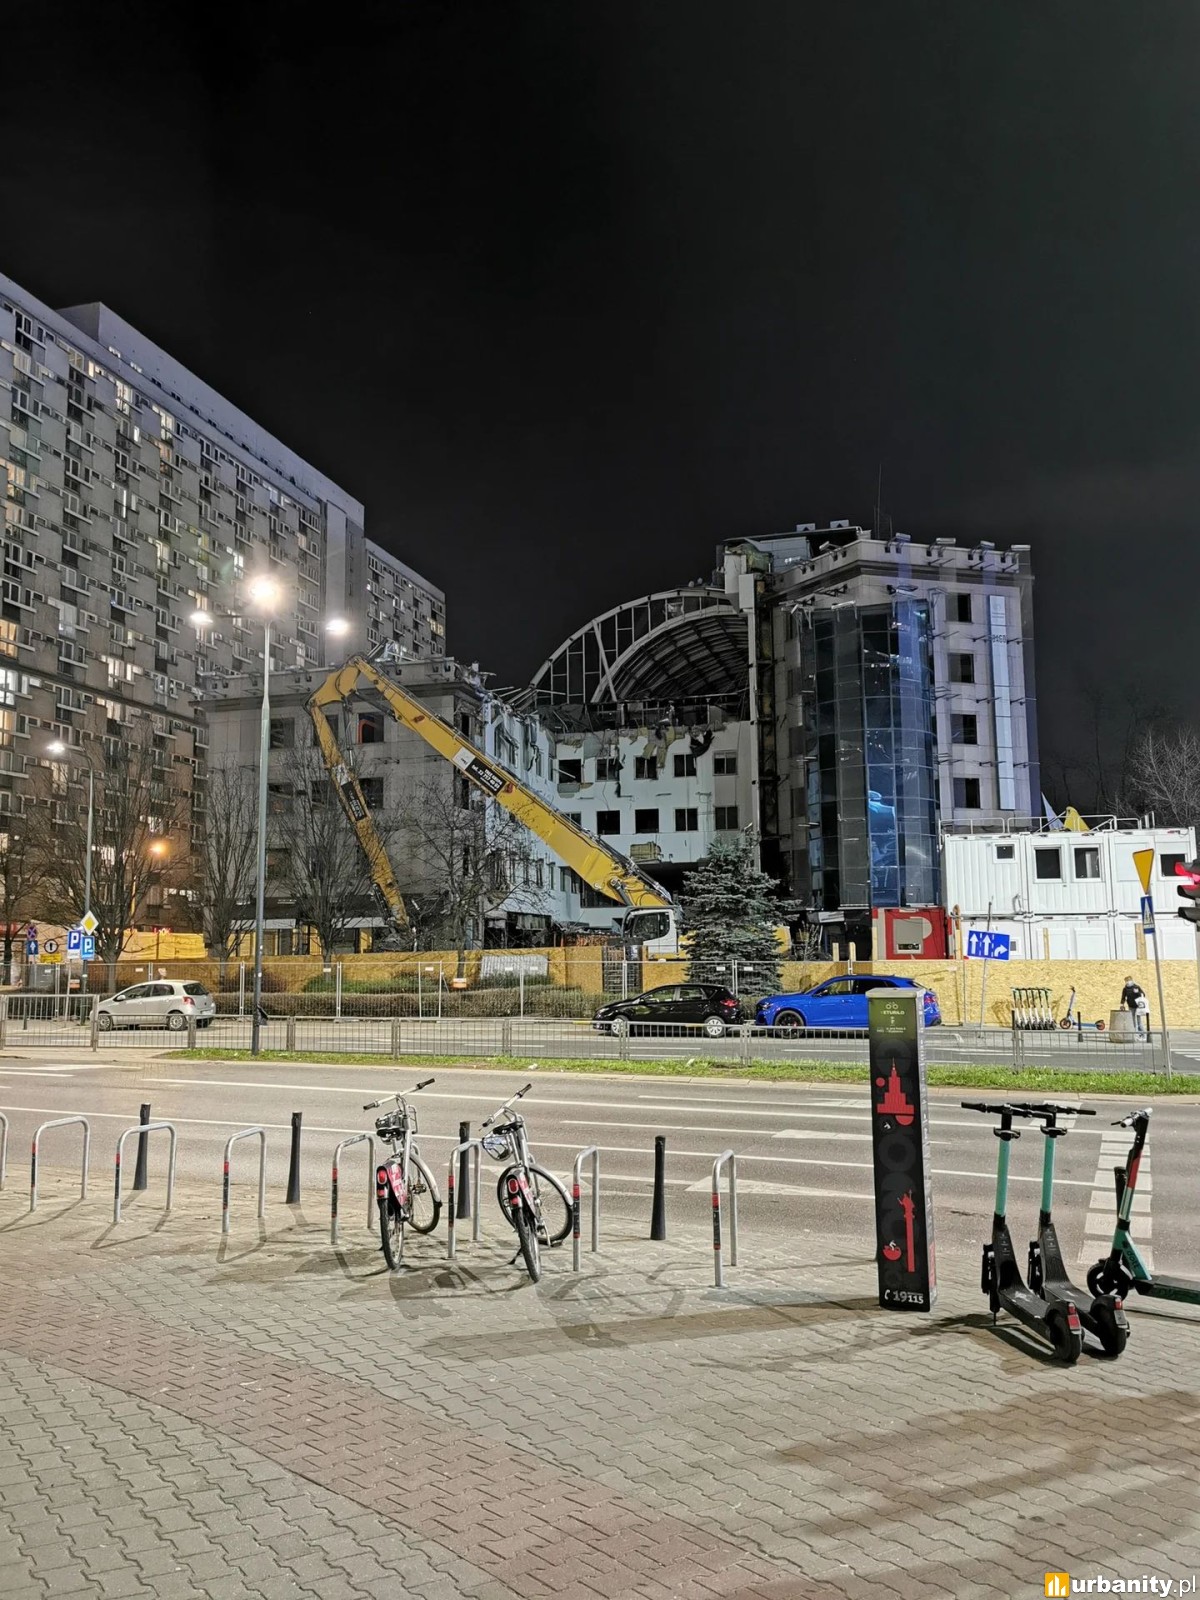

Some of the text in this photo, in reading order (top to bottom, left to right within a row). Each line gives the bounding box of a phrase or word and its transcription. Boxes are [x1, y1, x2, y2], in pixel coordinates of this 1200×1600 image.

[70, 932, 80, 948] P
[84, 938, 93, 953] P
[1127, 1250, 1140, 1269] dott
